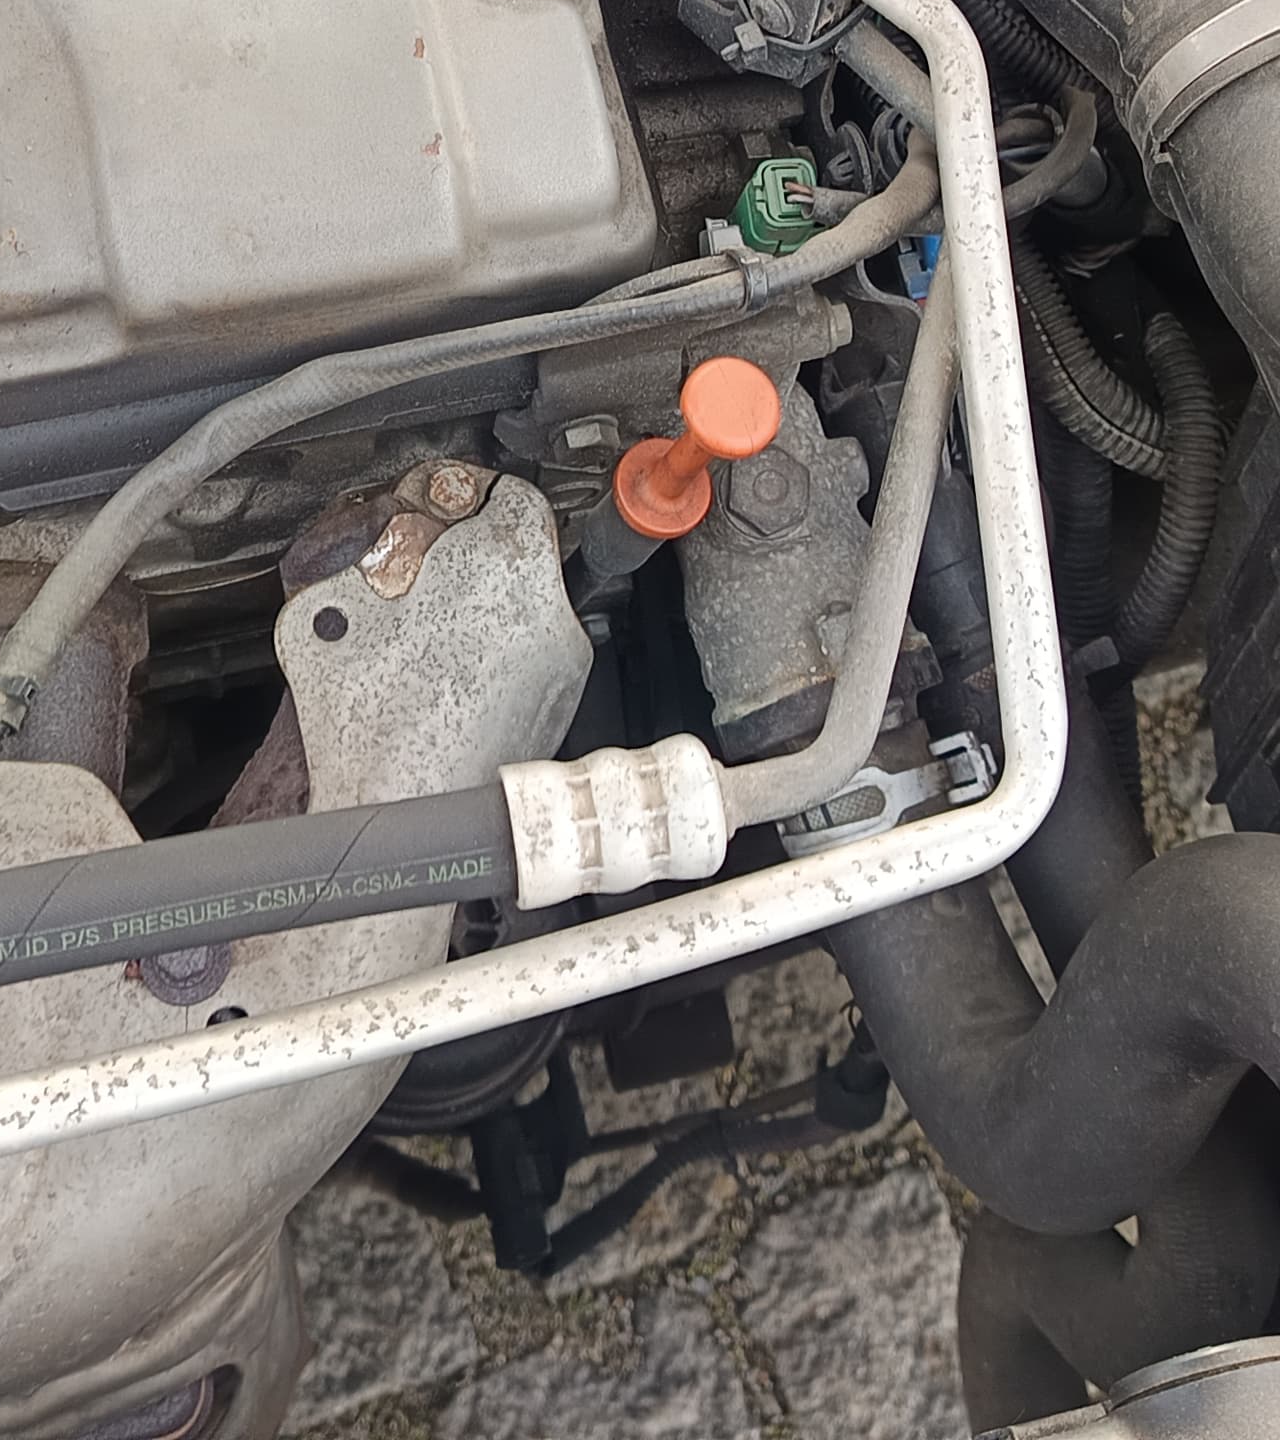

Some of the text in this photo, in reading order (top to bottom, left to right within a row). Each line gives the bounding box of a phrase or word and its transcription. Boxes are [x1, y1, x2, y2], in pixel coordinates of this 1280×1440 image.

[25, 936, 49, 958] ID
[60, 927, 101, 951] P/S
[112, 898, 237, 940] PRESSURE
[428, 855, 494, 885] MADE
